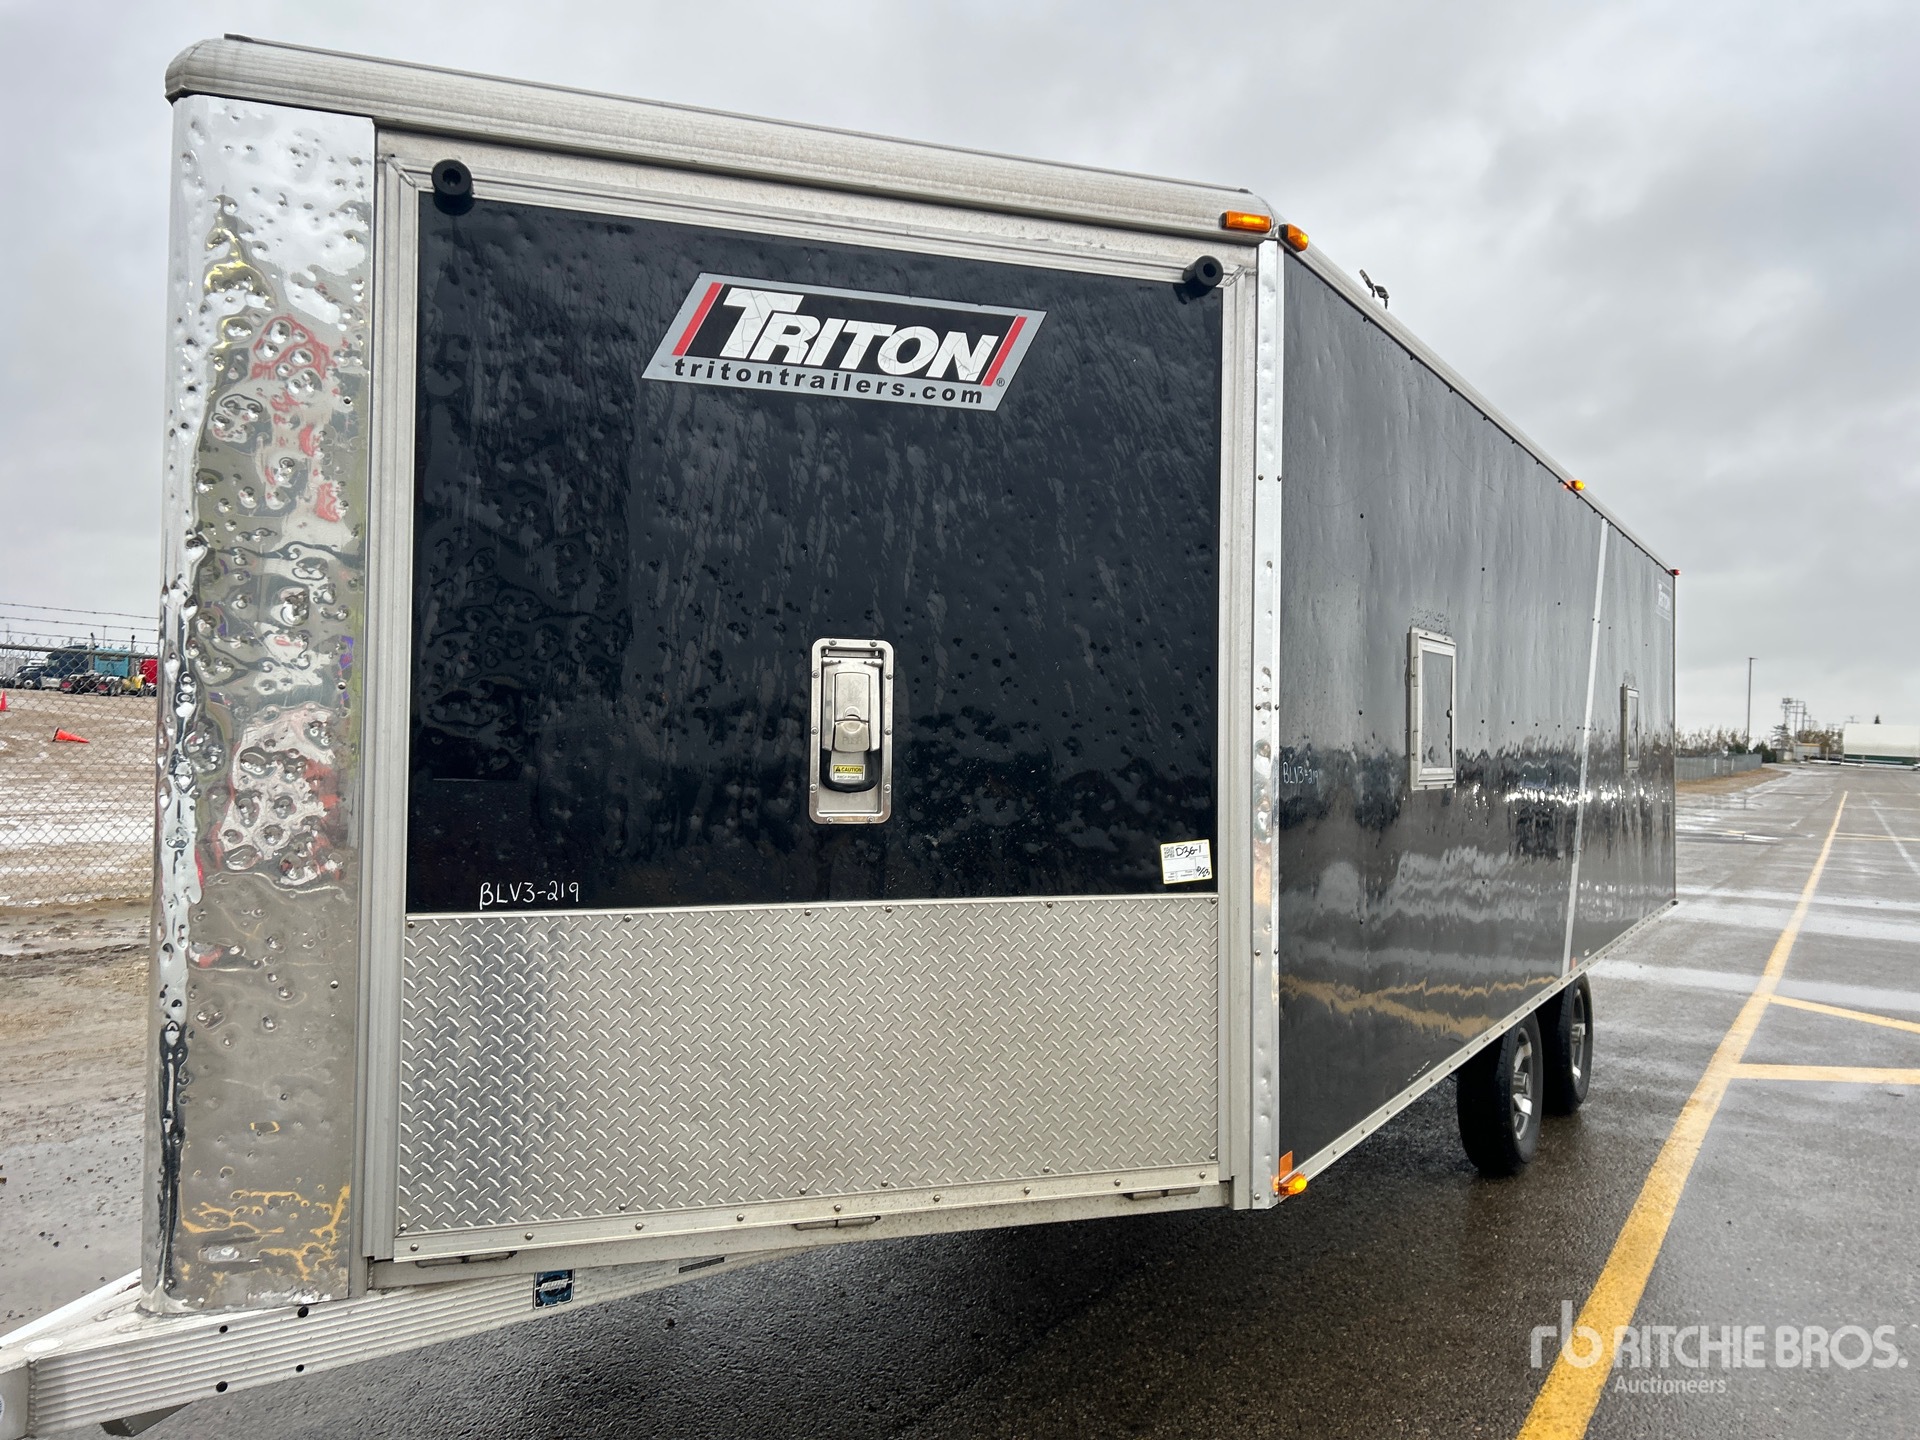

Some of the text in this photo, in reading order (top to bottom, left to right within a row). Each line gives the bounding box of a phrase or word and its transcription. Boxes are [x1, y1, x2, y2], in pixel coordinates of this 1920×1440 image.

[719, 287, 999, 382] TRITON
[674, 357, 982, 404] tritontrailers.com
[479, 880, 579, 910] BLV3-219
